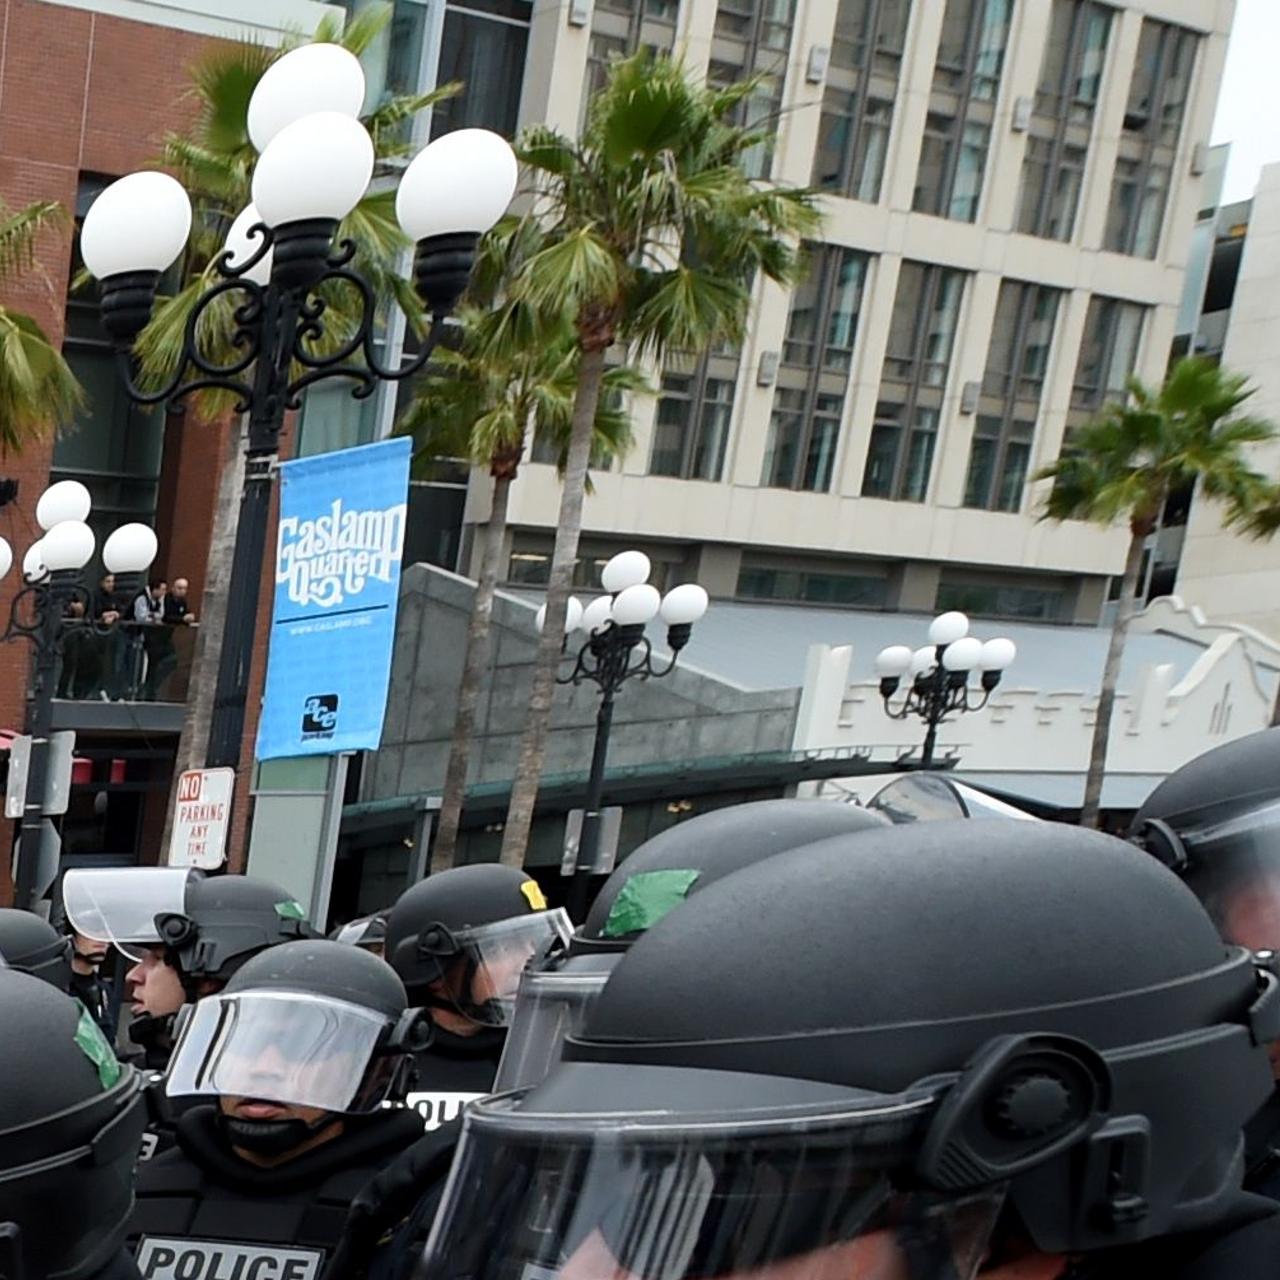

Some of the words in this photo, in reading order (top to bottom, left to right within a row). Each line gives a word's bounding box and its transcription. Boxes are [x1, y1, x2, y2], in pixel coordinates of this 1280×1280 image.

[276, 499, 407, 584] Gaslamp
[288, 550, 391, 607] Quarter
[180, 775, 200, 799] NO
[180, 803, 224, 822] PARKING
[190, 825, 208, 838] ANY
[187, 842, 207, 855] TIME
